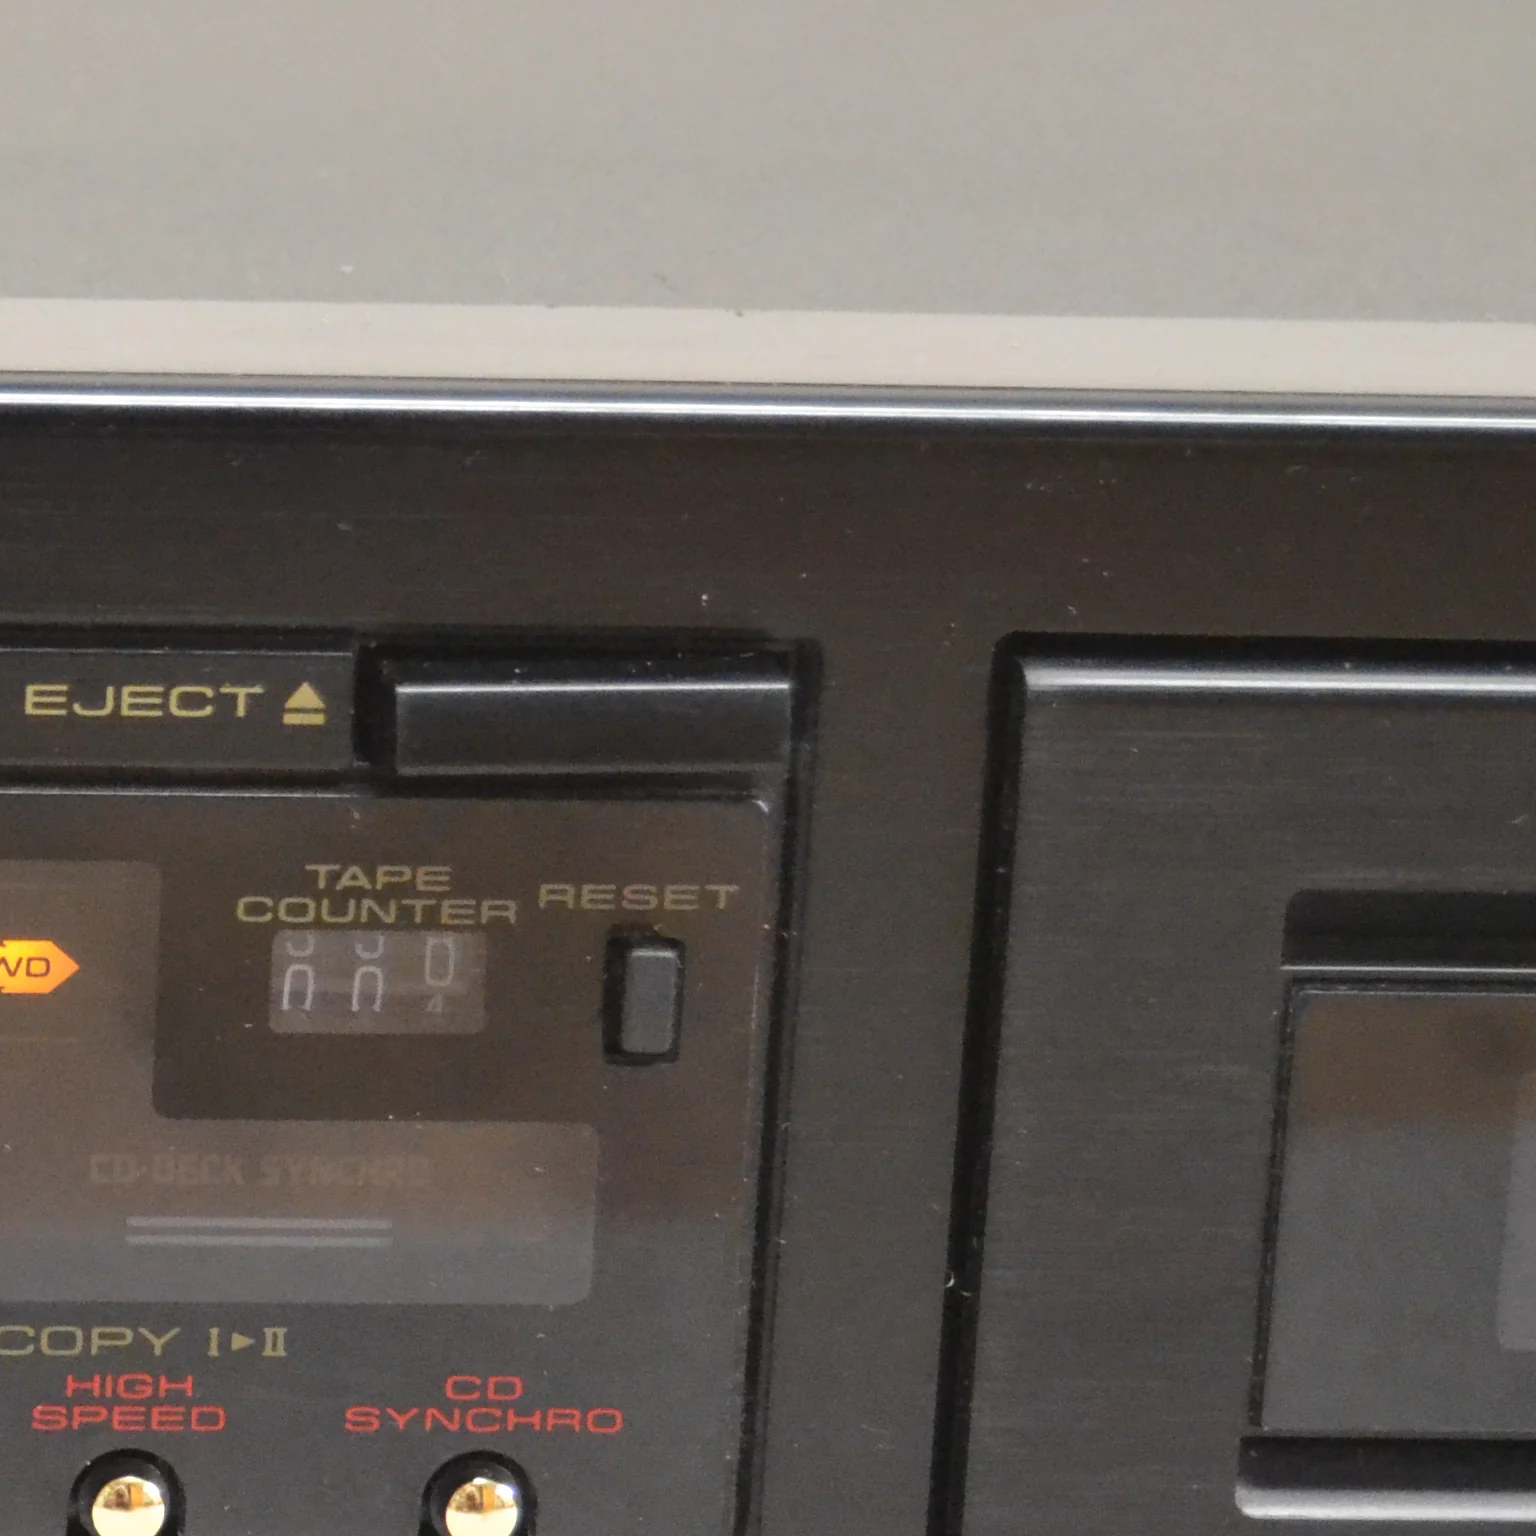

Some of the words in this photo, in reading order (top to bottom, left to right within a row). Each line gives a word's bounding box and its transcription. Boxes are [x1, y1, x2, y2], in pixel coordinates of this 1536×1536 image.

[25, 684, 264, 717] EJECT
[305, 864, 450, 891] TAPE
[237, 896, 516, 924] COUNTER
[537, 883, 740, 913] RESET
[66, 1374, 193, 1399] HIGH
[446, 1376, 523, 1400] CD
[32, 1404, 227, 1433] SPEED
[345, 1407, 622, 1434] SYNCHRO
